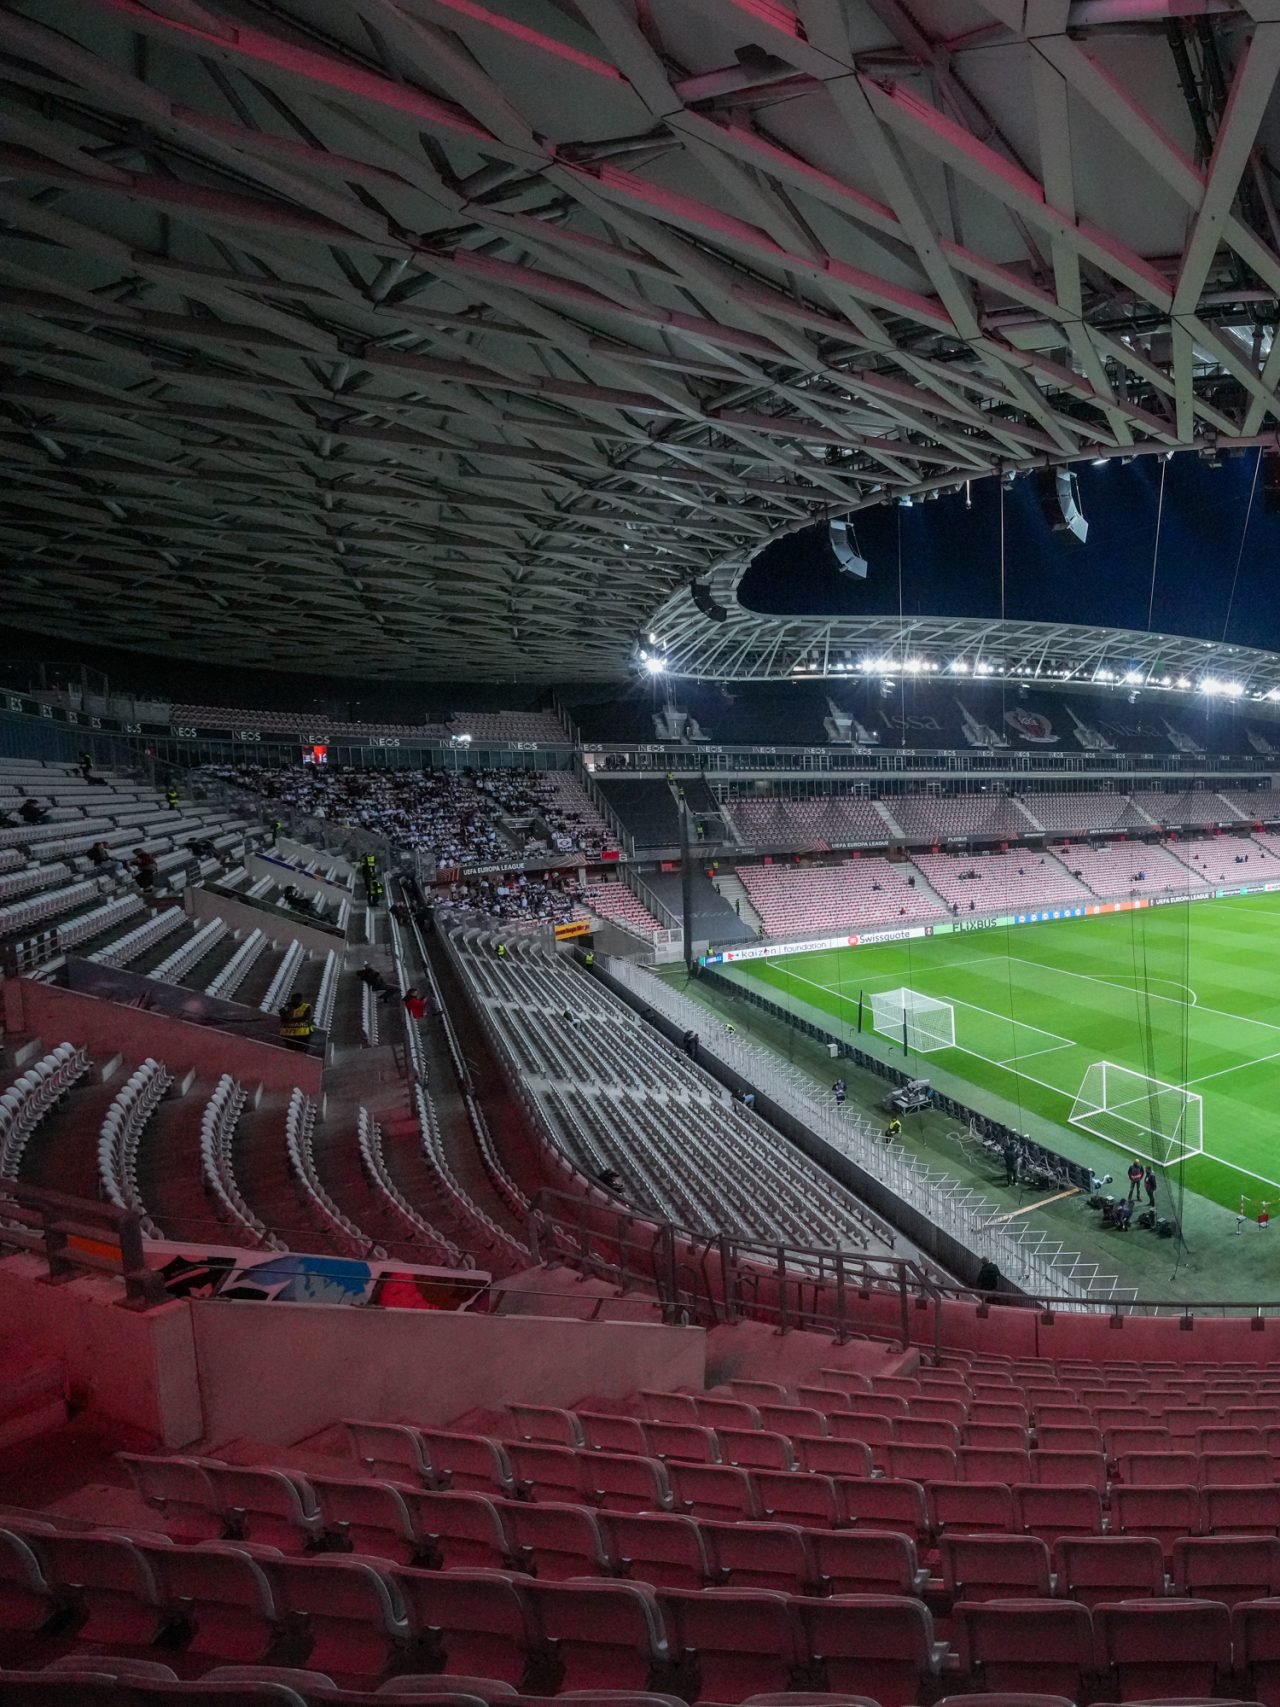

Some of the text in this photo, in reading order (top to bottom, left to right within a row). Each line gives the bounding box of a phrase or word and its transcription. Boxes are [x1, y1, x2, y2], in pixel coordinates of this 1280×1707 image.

[171, 726, 197, 737] INEOS
[232, 730, 261, 741] INEOS
[300, 735, 330, 744] INEOS
[370, 737, 400, 747] INEOS
[440, 740, 470, 749] INEOS
[508, 742, 538, 751] INEOS
[463, 862, 525, 876] UEFA EUROPA LEAGUE
[1170, 895, 1190, 903] EUROPA
[1190, 893, 1209, 901] LEAGUE
[859, 931, 910, 944] Swissquote
[784, 941, 827, 953] foundation
